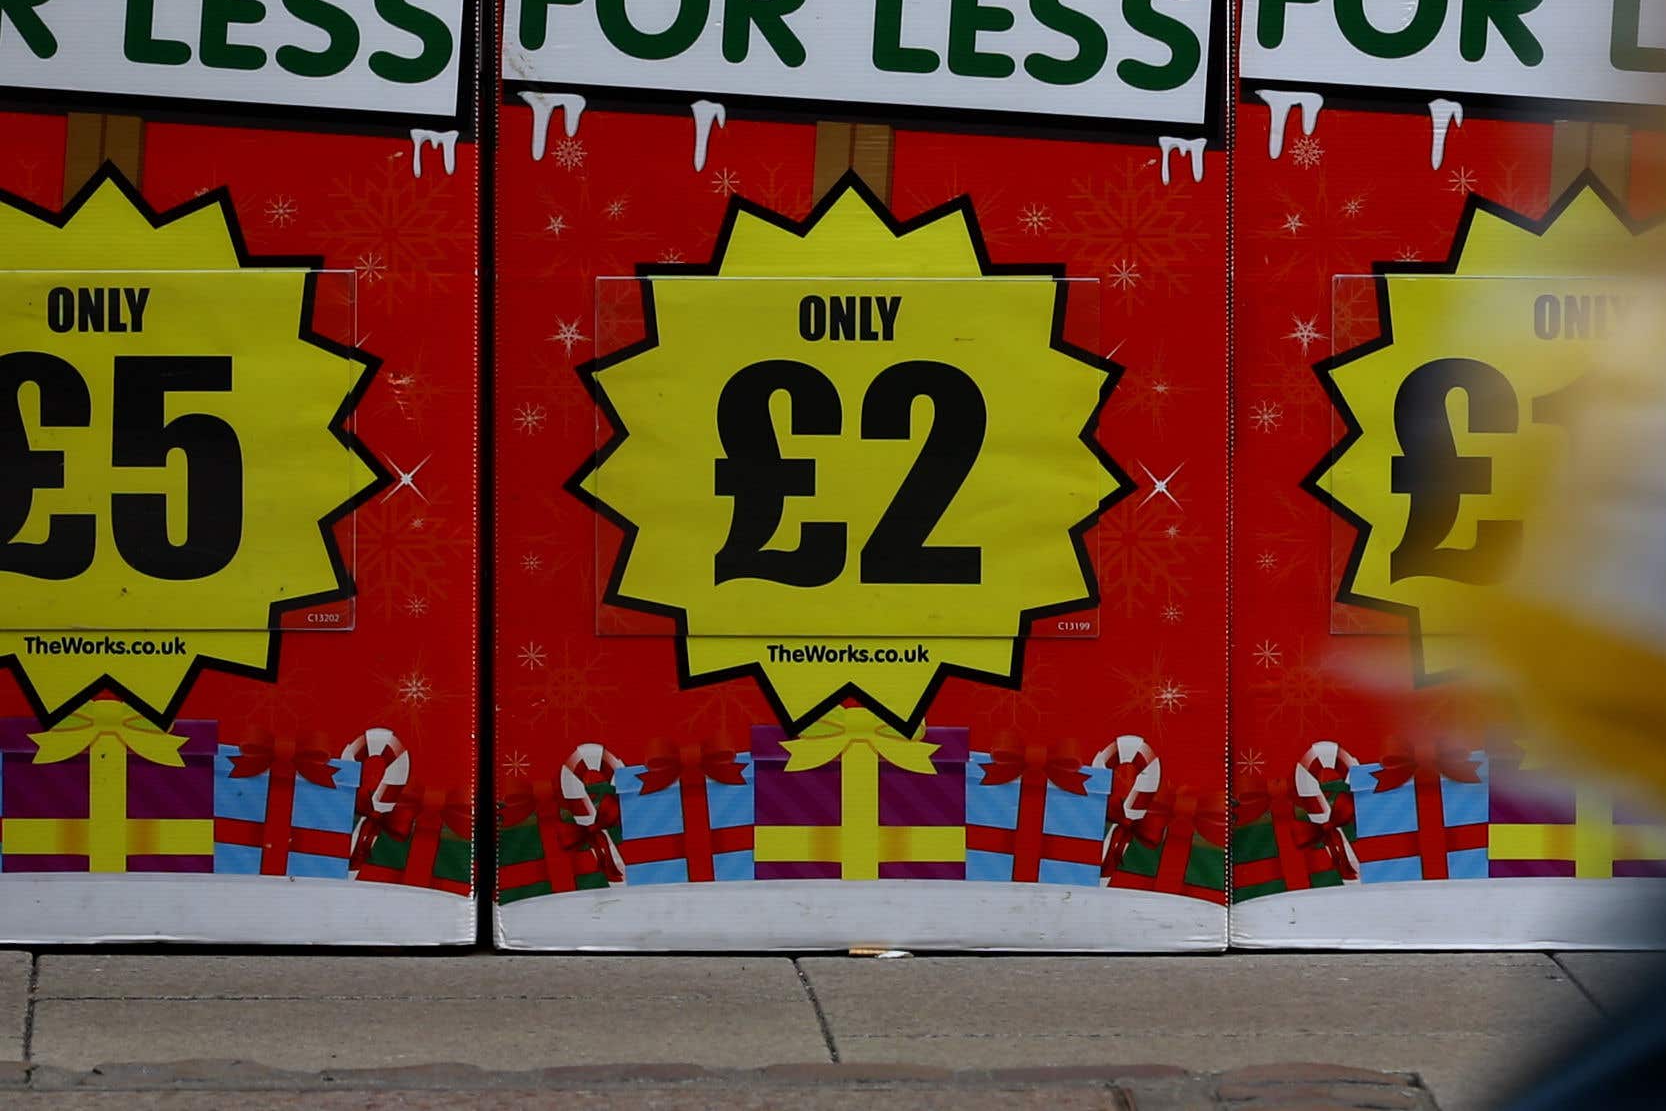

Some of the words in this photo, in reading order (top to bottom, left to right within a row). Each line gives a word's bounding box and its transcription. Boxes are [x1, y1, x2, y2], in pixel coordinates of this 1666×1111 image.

[47, 286, 151, 334] ONLY
[798, 294, 902, 342] ONLY
[0, 350, 244, 581] £5
[714, 358, 988, 588] £2
[307, 612, 341, 623] C13202
[24, 635, 187, 656] TheWorks.co.uk
[766, 644, 930, 664] TheWorks.co.uk
